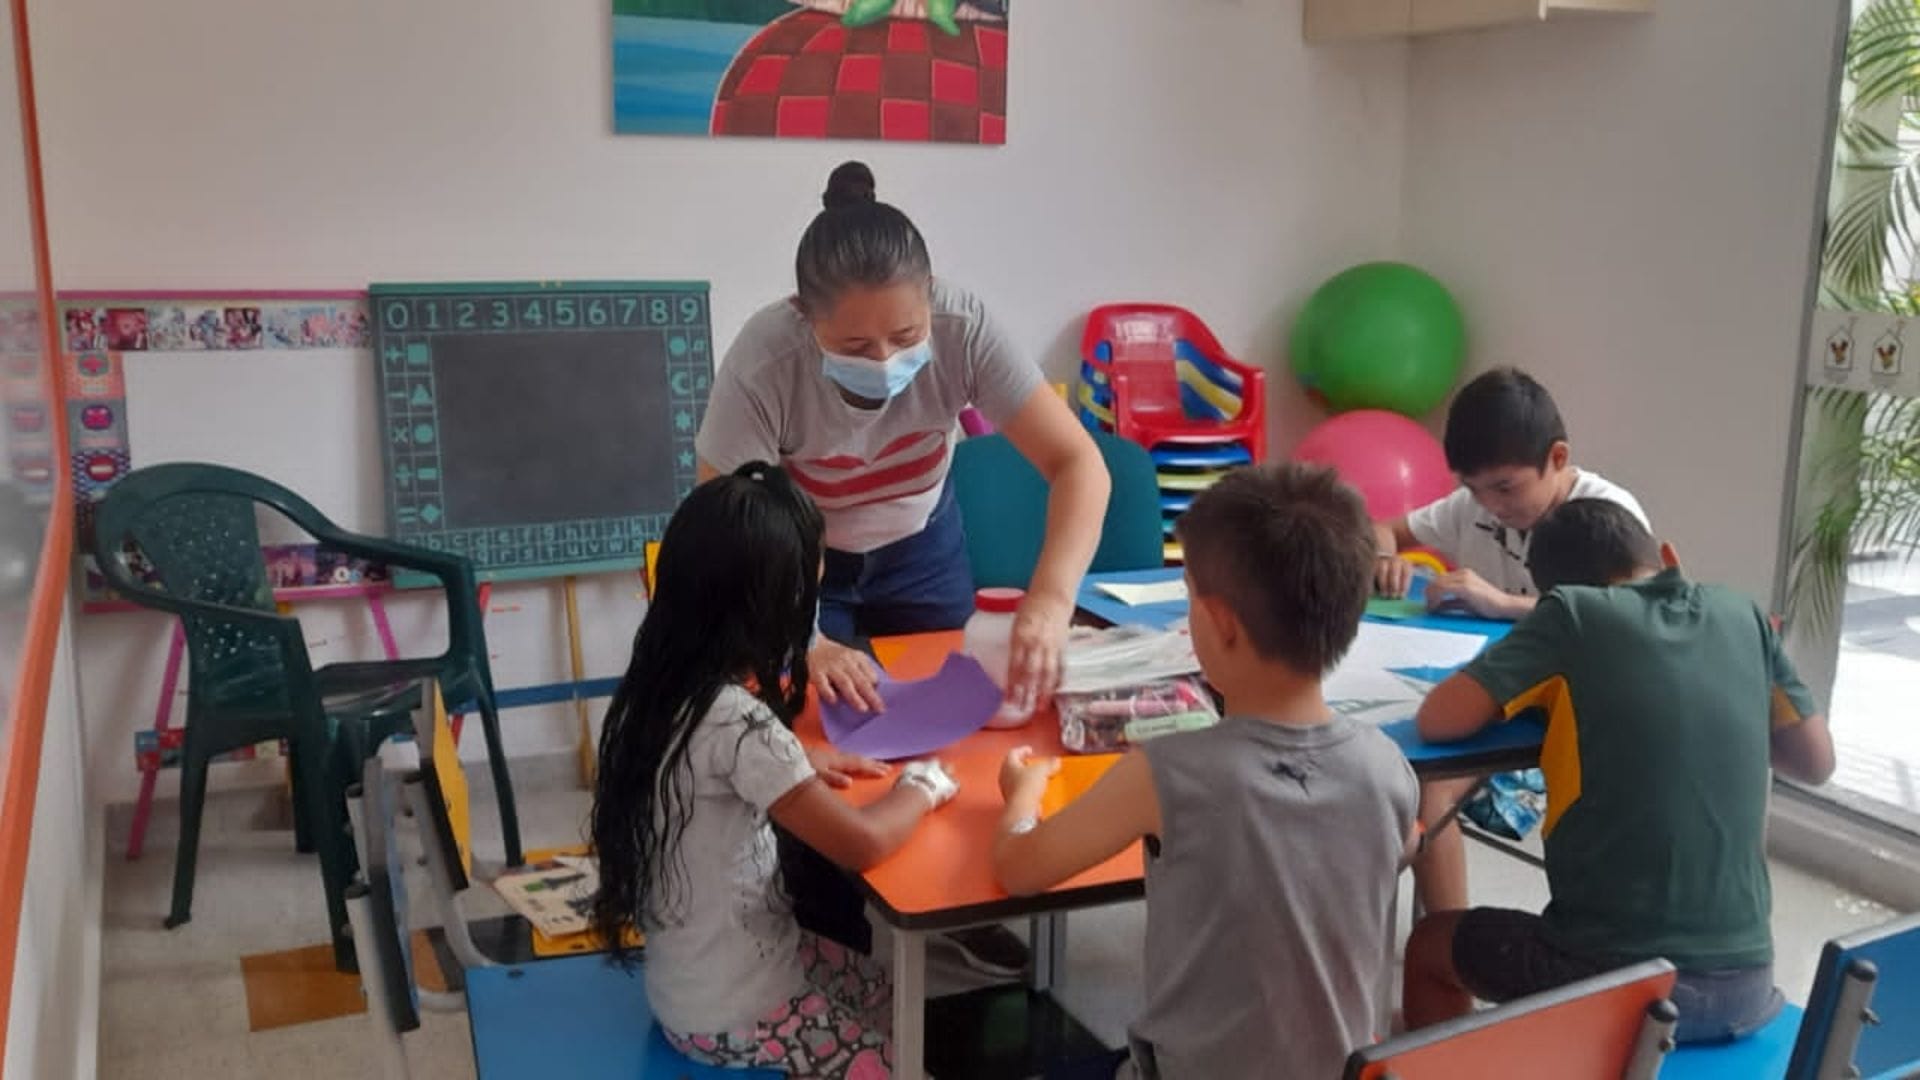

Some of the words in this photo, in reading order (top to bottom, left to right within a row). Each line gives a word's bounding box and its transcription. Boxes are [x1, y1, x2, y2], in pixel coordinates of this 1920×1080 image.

[386, 302, 409, 330] 0
[425, 302, 440, 329] 1
[456, 302, 476, 328] 2
[492, 301, 510, 327] 3
[523, 300, 543, 326] 4
[555, 299, 576, 326] 5
[588, 299, 607, 325] 6
[618, 299, 637, 325] 7
[651, 299, 669, 324] 8
[680, 298, 699, 324] 9
